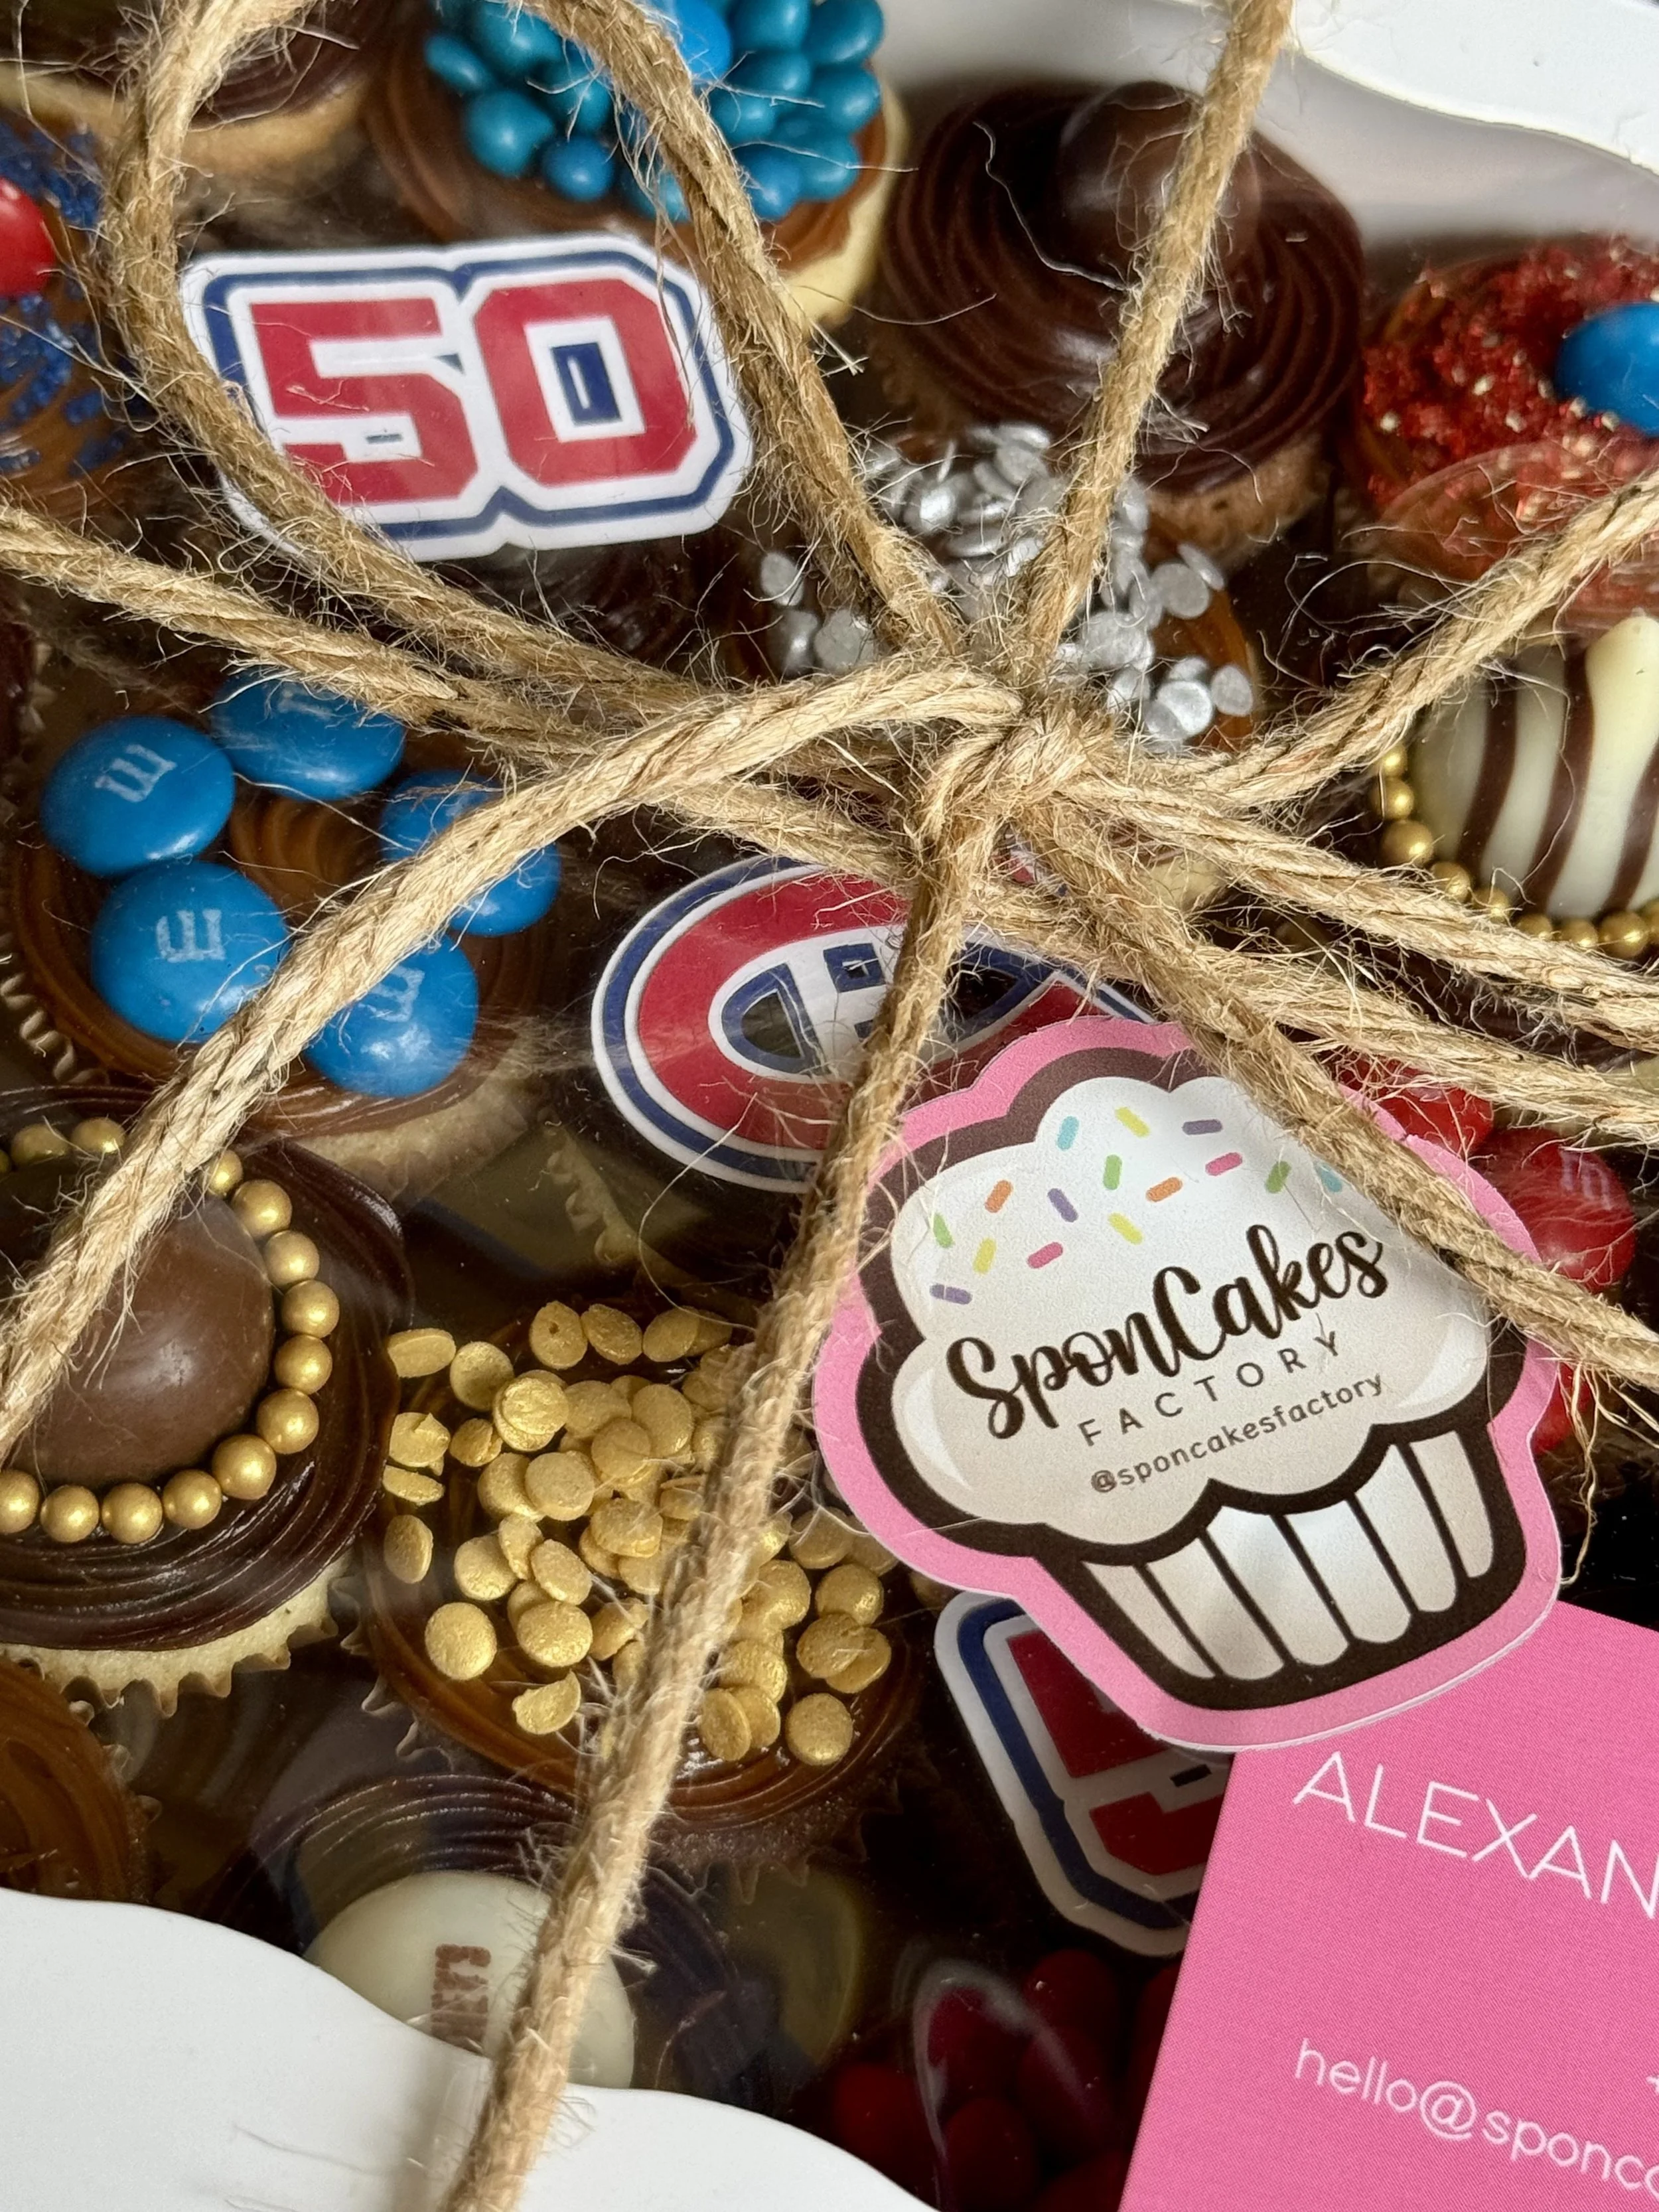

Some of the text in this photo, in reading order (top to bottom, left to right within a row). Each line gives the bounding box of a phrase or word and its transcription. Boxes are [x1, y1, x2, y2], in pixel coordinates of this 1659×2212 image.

[250, 278, 697, 506] 50
[947, 1224, 1390, 1439] SponCakes
[1078, 1331, 1341, 1447] FACTORY
[1091, 1372, 1384, 1493] @sponcakesfactory
[1293, 1751, 1659, 1920] ALEXAN
